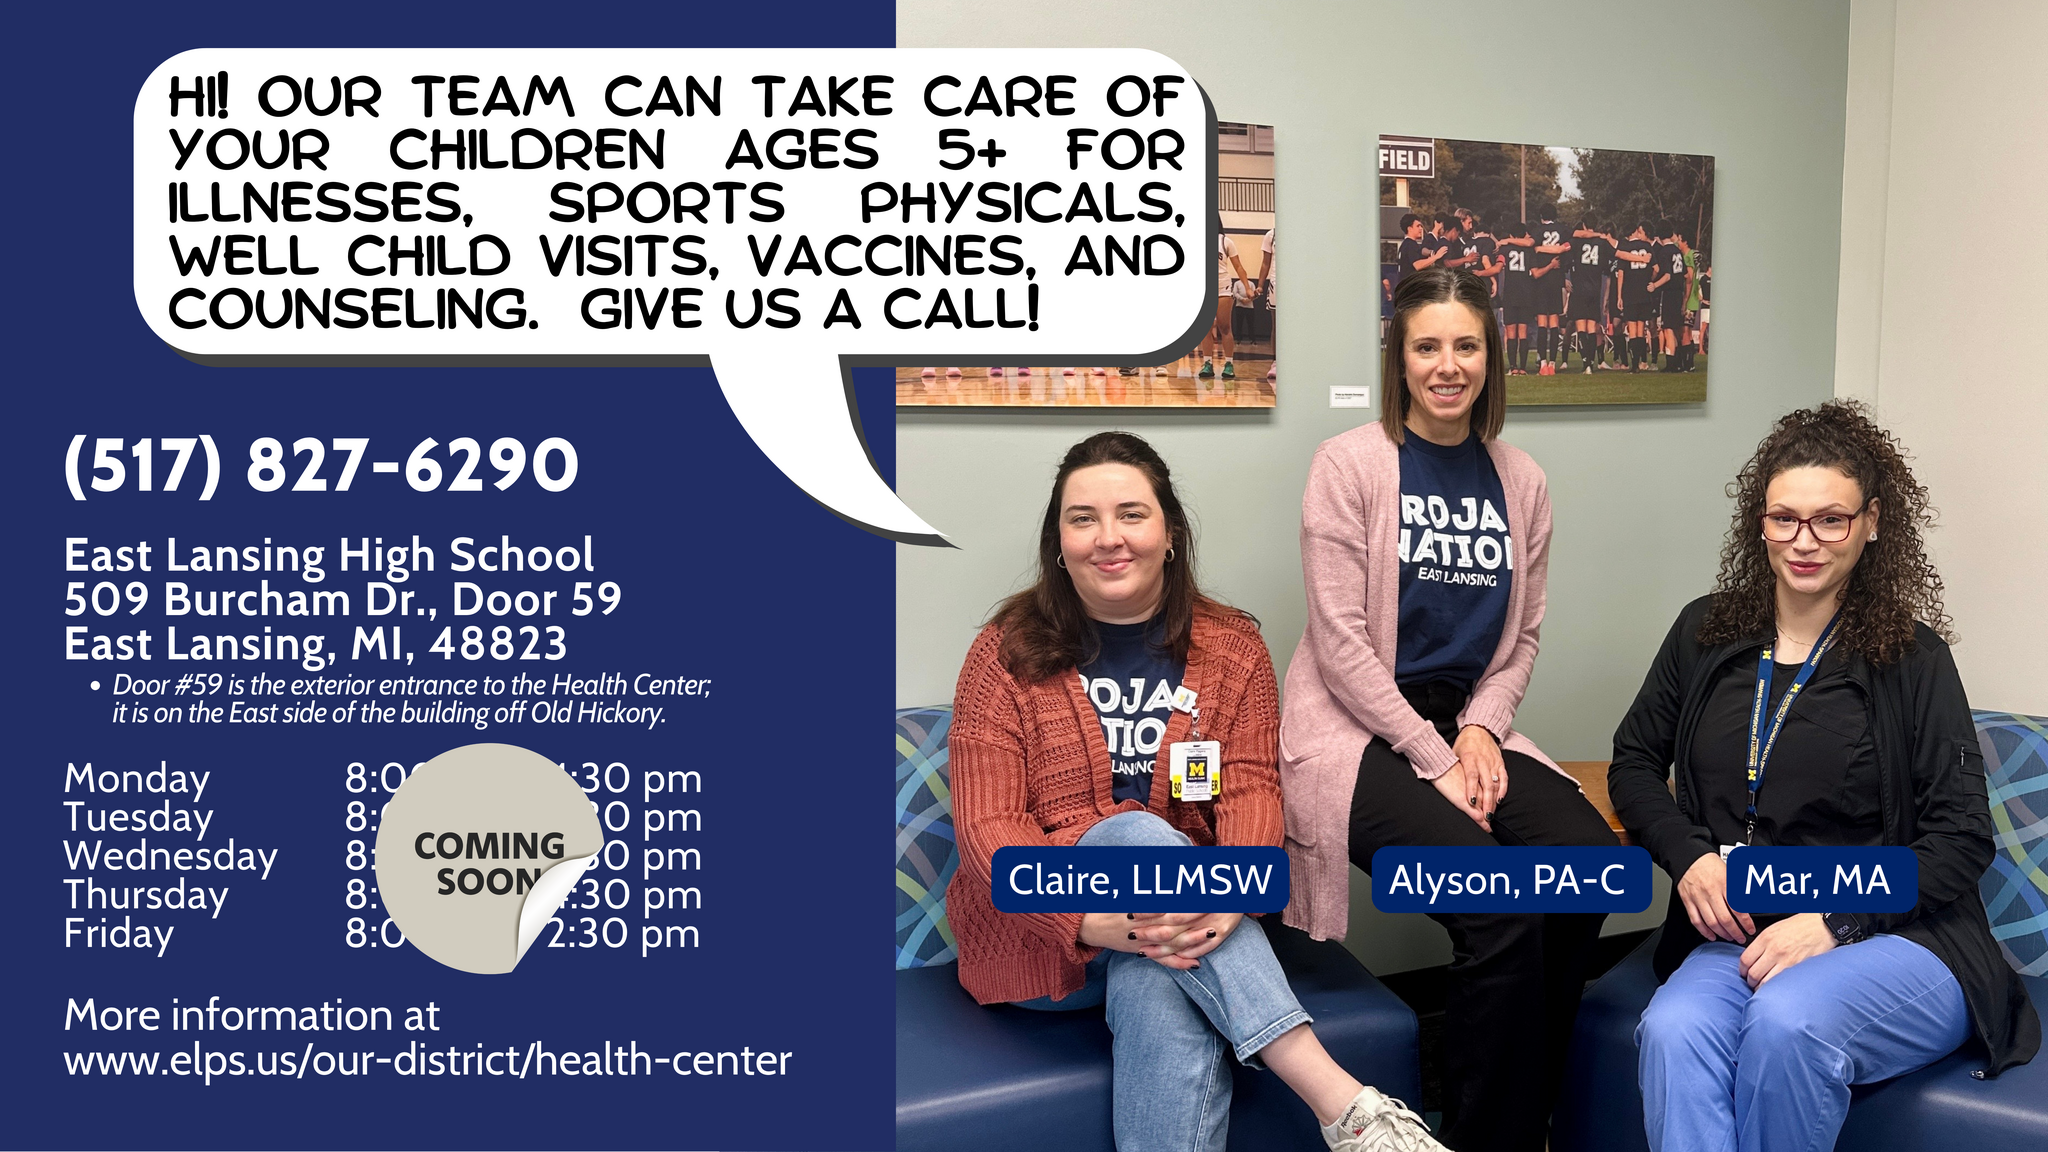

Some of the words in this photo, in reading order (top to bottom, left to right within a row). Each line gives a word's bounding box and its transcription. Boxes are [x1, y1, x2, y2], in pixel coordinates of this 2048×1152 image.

[1379, 149, 1430, 170] FIELD
[1508, 250, 1525, 271] 21
[1581, 244, 1599, 265] 24
[1400, 493, 1507, 532] ROJA
[1444, 571, 1497, 586] LANSING
[1079, 674, 1174, 714] OJA
[1341, 1105, 1357, 1128] Reebok
